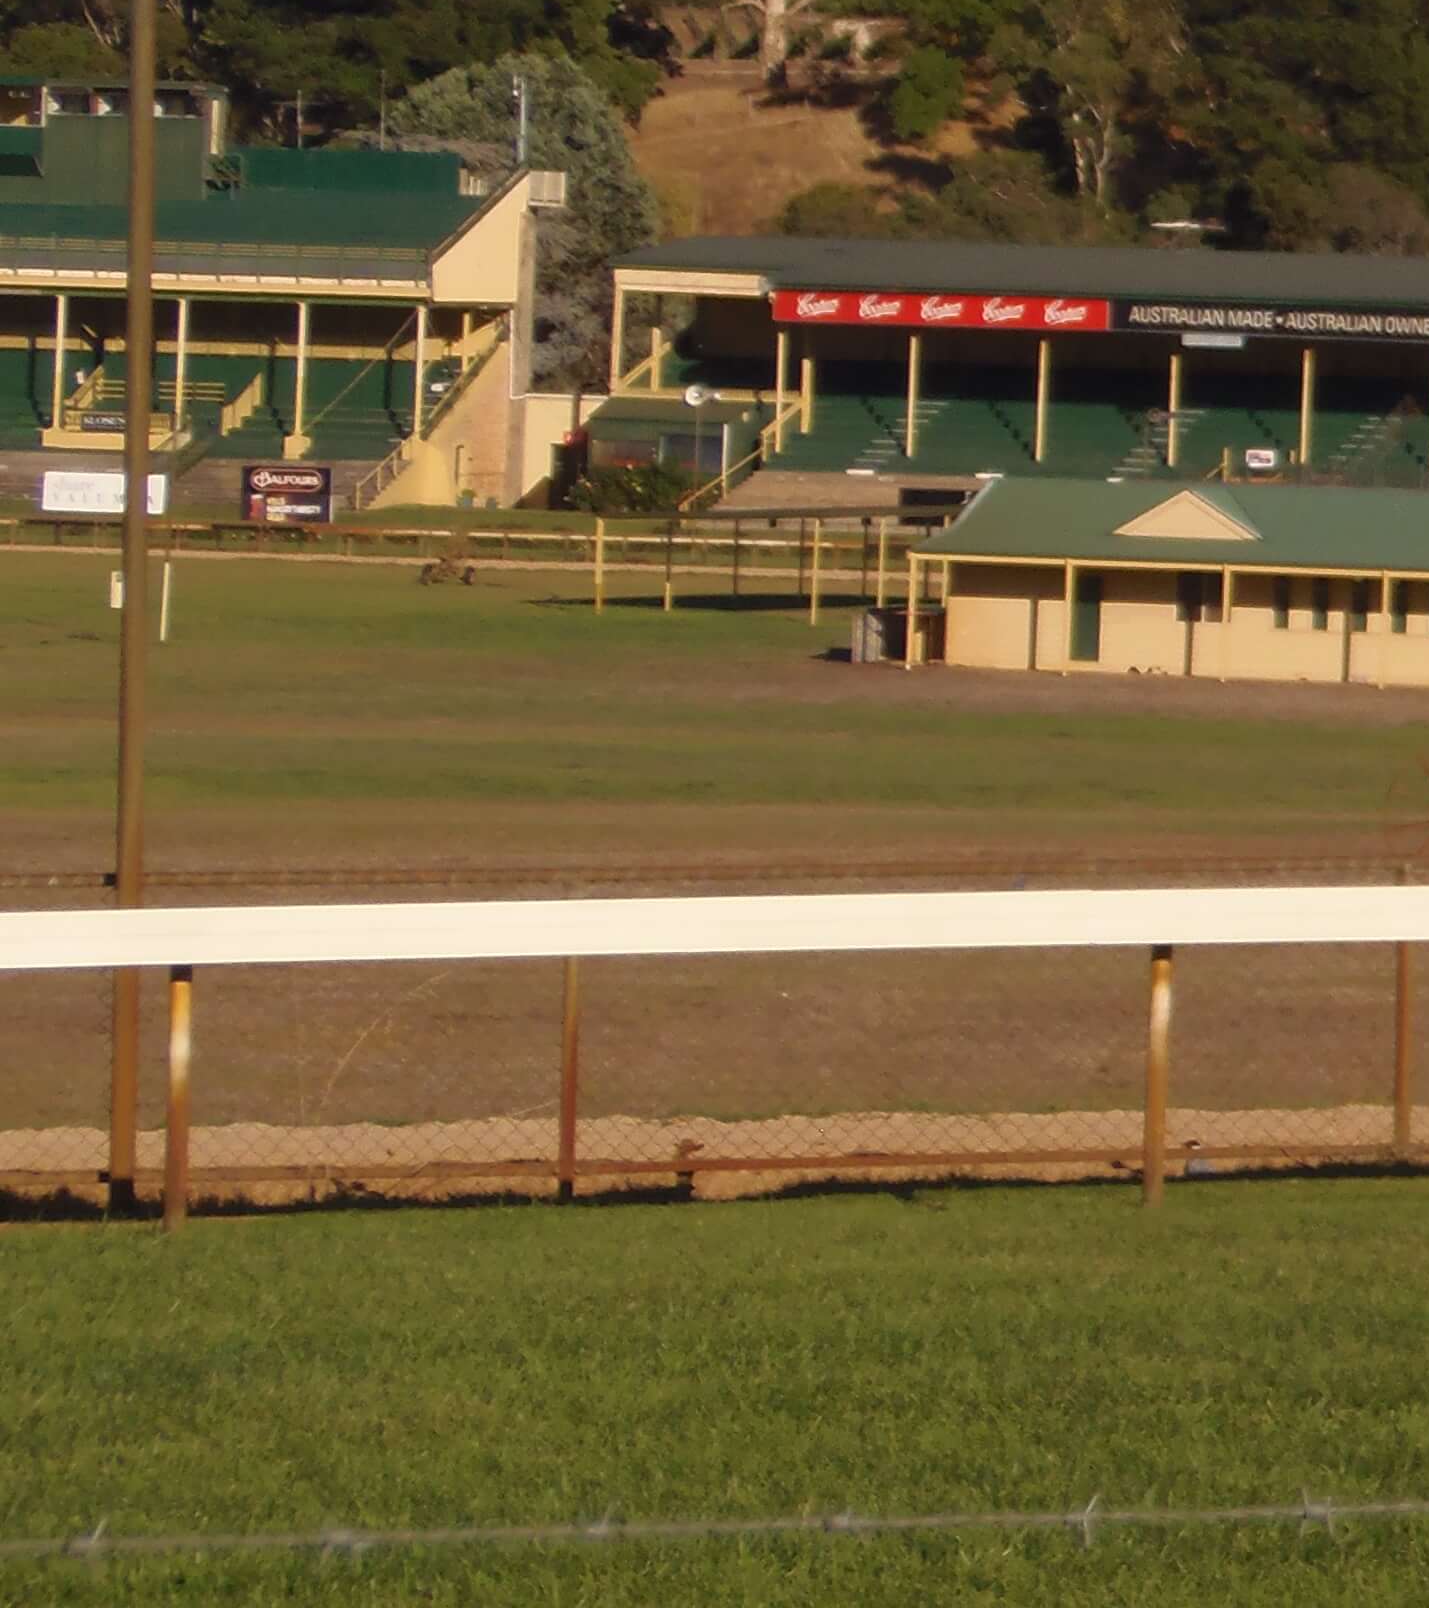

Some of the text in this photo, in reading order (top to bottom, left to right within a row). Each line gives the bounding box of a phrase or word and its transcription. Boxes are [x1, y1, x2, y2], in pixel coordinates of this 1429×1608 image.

[1129, 306, 1224, 327] AUSTRALIAN
[1229, 309, 1274, 328] MADE
[1285, 316, 1382, 334] AUSTRALIAN
